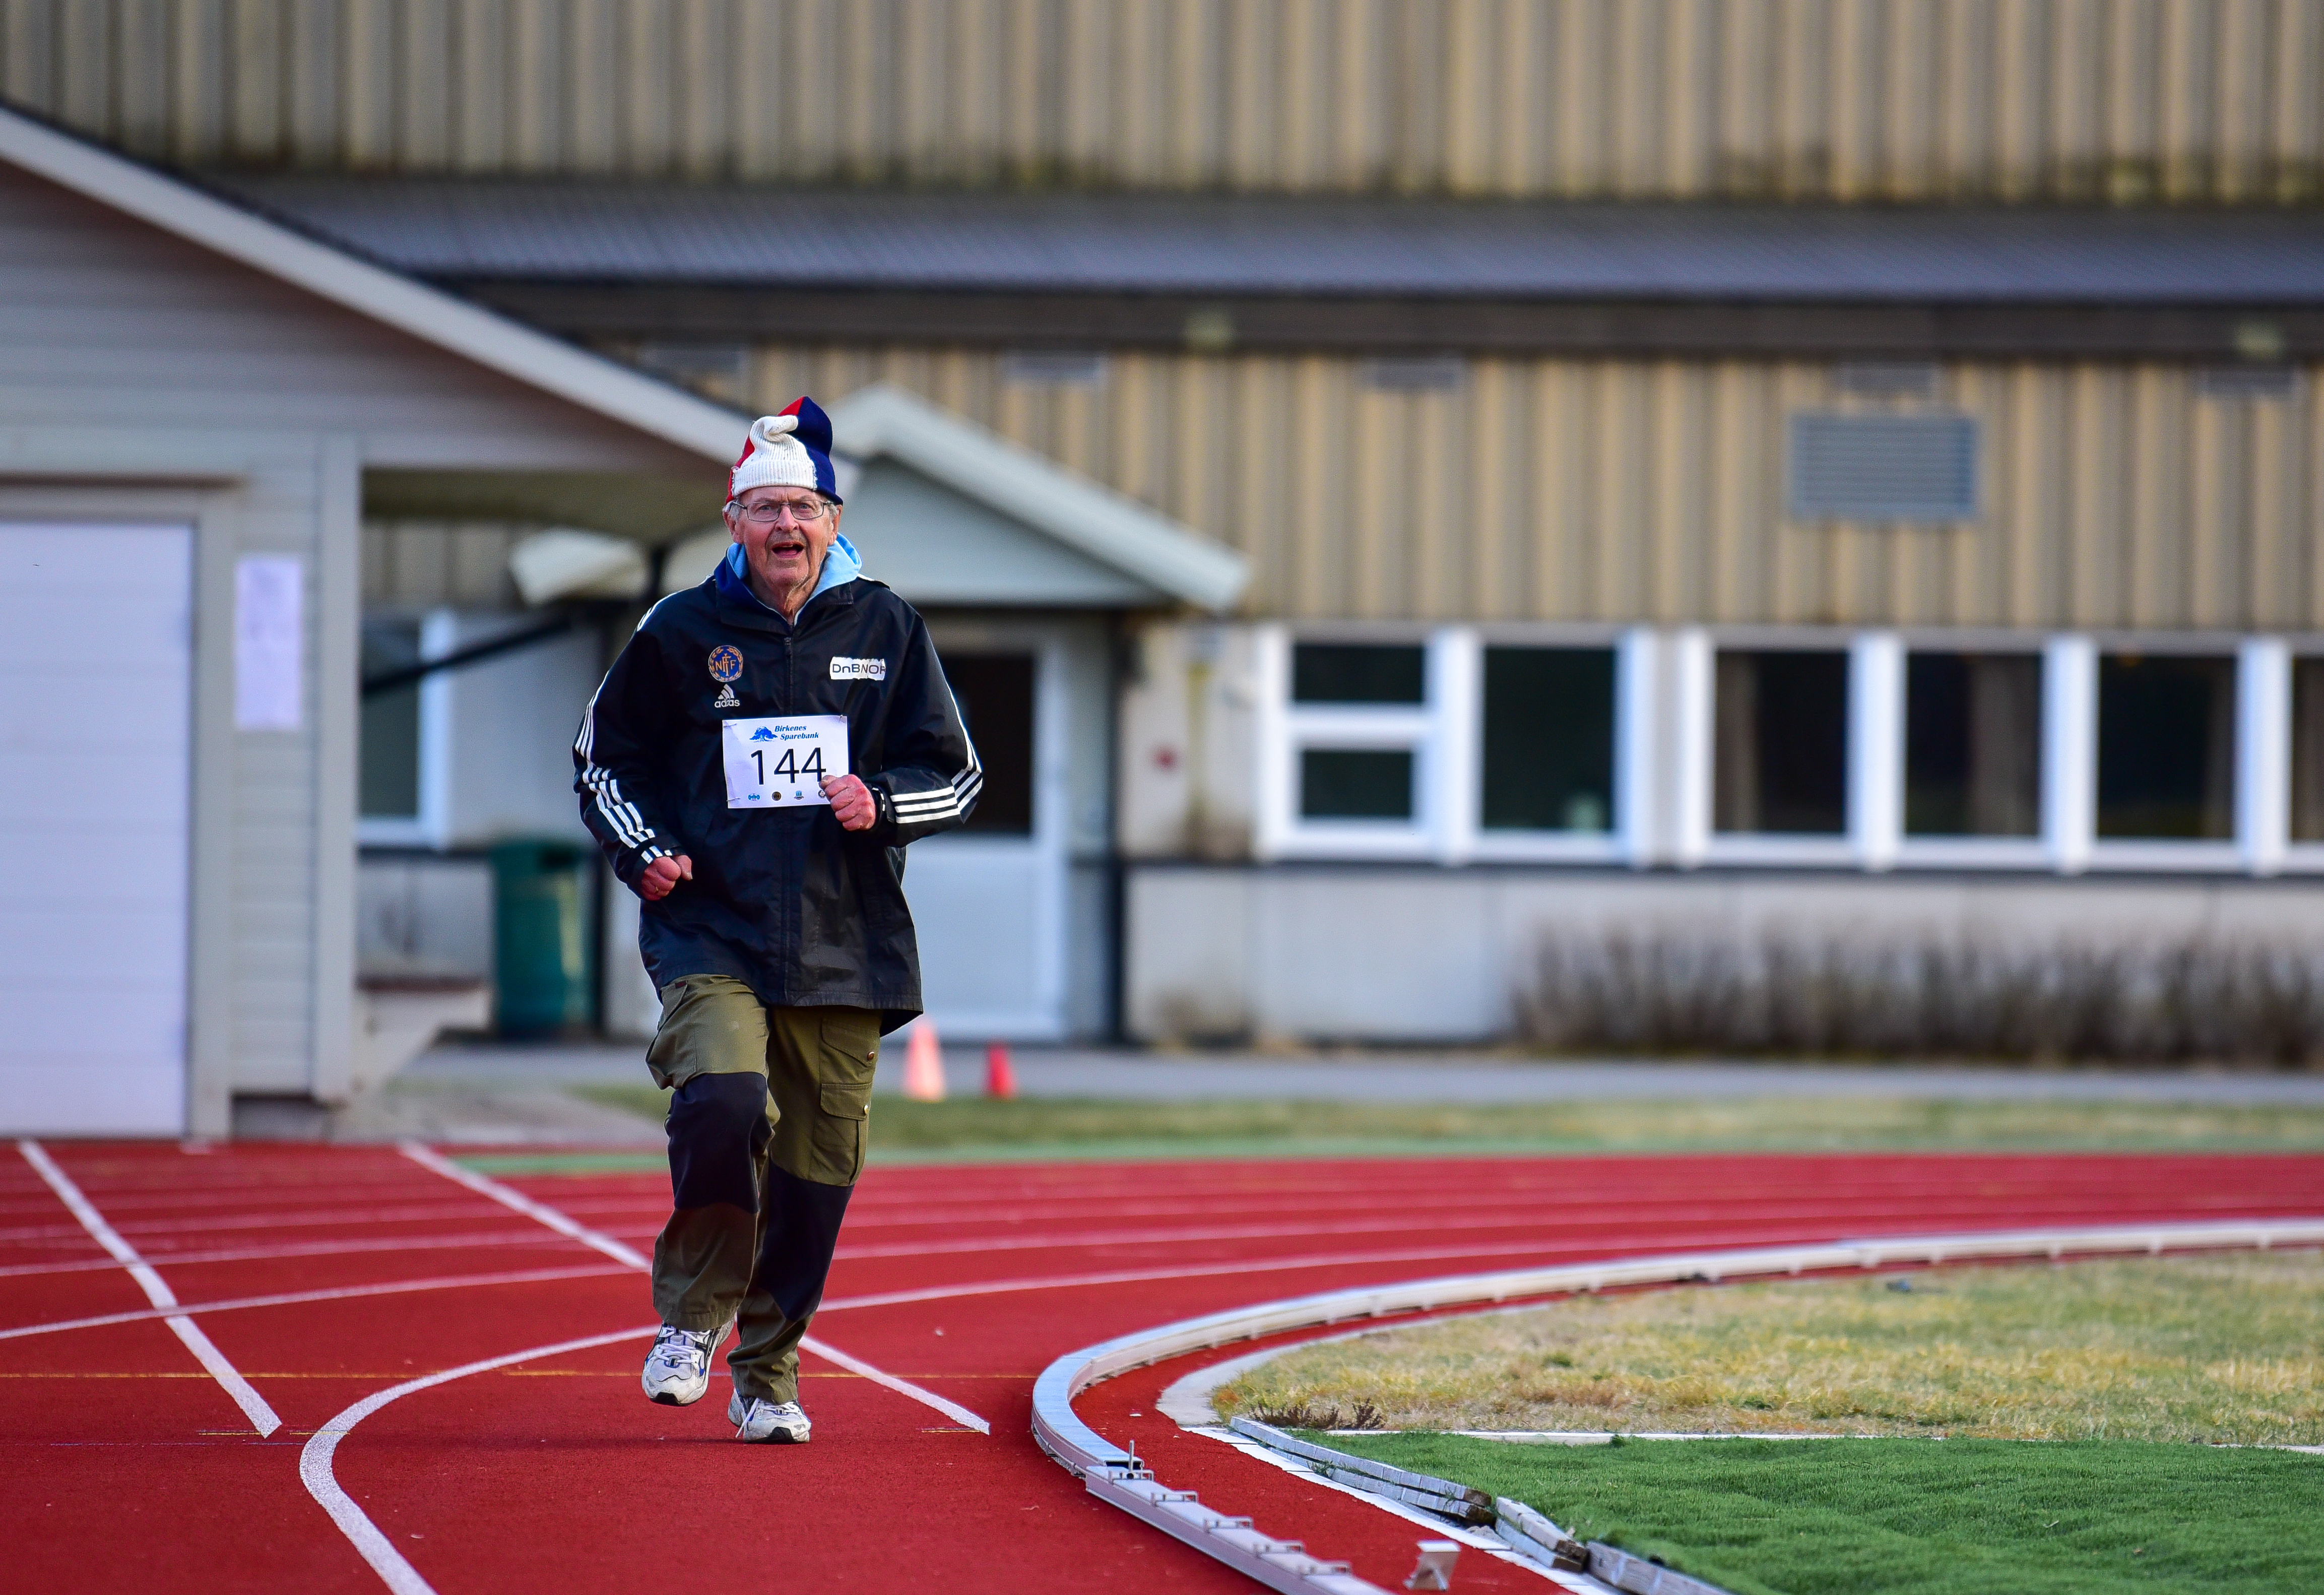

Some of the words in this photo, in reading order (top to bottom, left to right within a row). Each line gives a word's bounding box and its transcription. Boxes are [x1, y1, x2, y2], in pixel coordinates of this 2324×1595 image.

[714, 698, 740, 708] addas
[780, 732, 819, 741] Sparebank
[751, 747, 826, 785] 144
